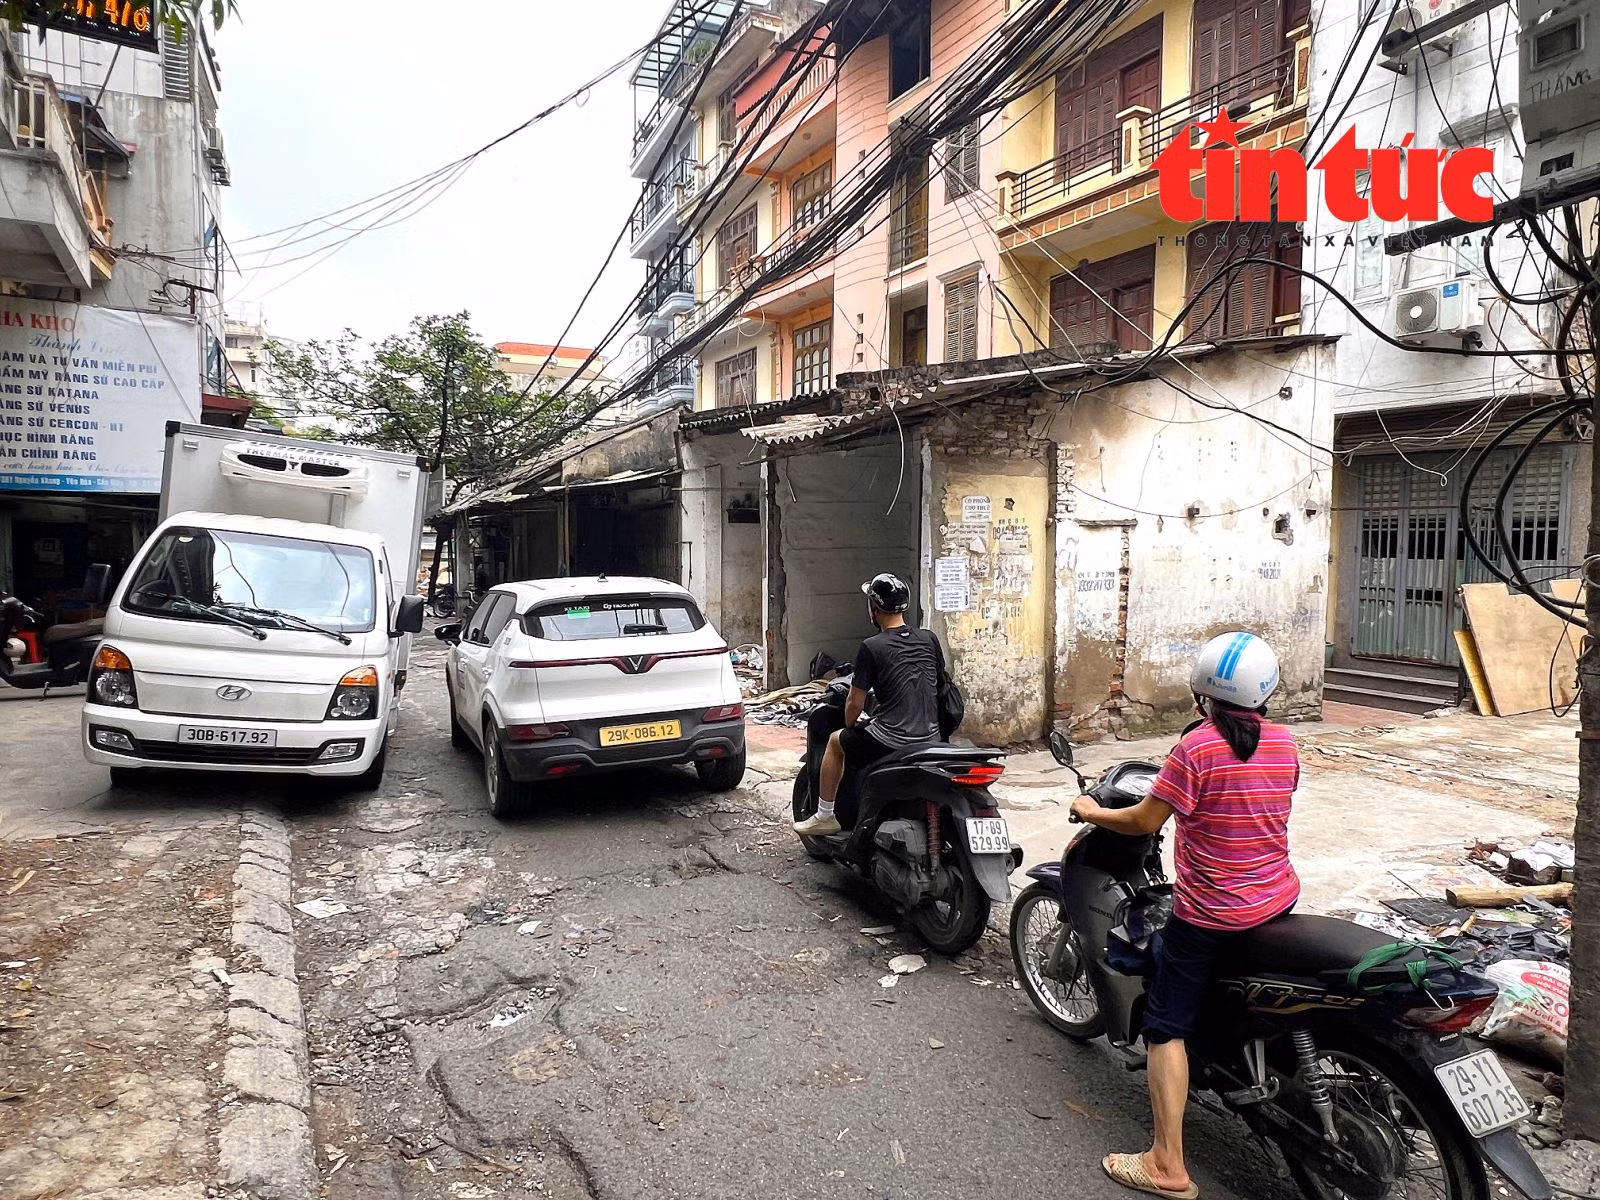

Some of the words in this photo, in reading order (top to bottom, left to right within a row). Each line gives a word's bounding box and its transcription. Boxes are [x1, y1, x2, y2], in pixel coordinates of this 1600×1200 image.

[48, 387, 99, 400] KATANA
[49, 403, 91, 415] VENUS
[49, 418, 99, 430] CERCON
[246, 448, 295, 460] THERMAL
[299, 455, 341, 467] MASTER
[187, 728, 269, 744] 30B-617.92
[971, 836, 1009, 850] 529.99
[1461, 1085, 1526, 1130] 607.35
